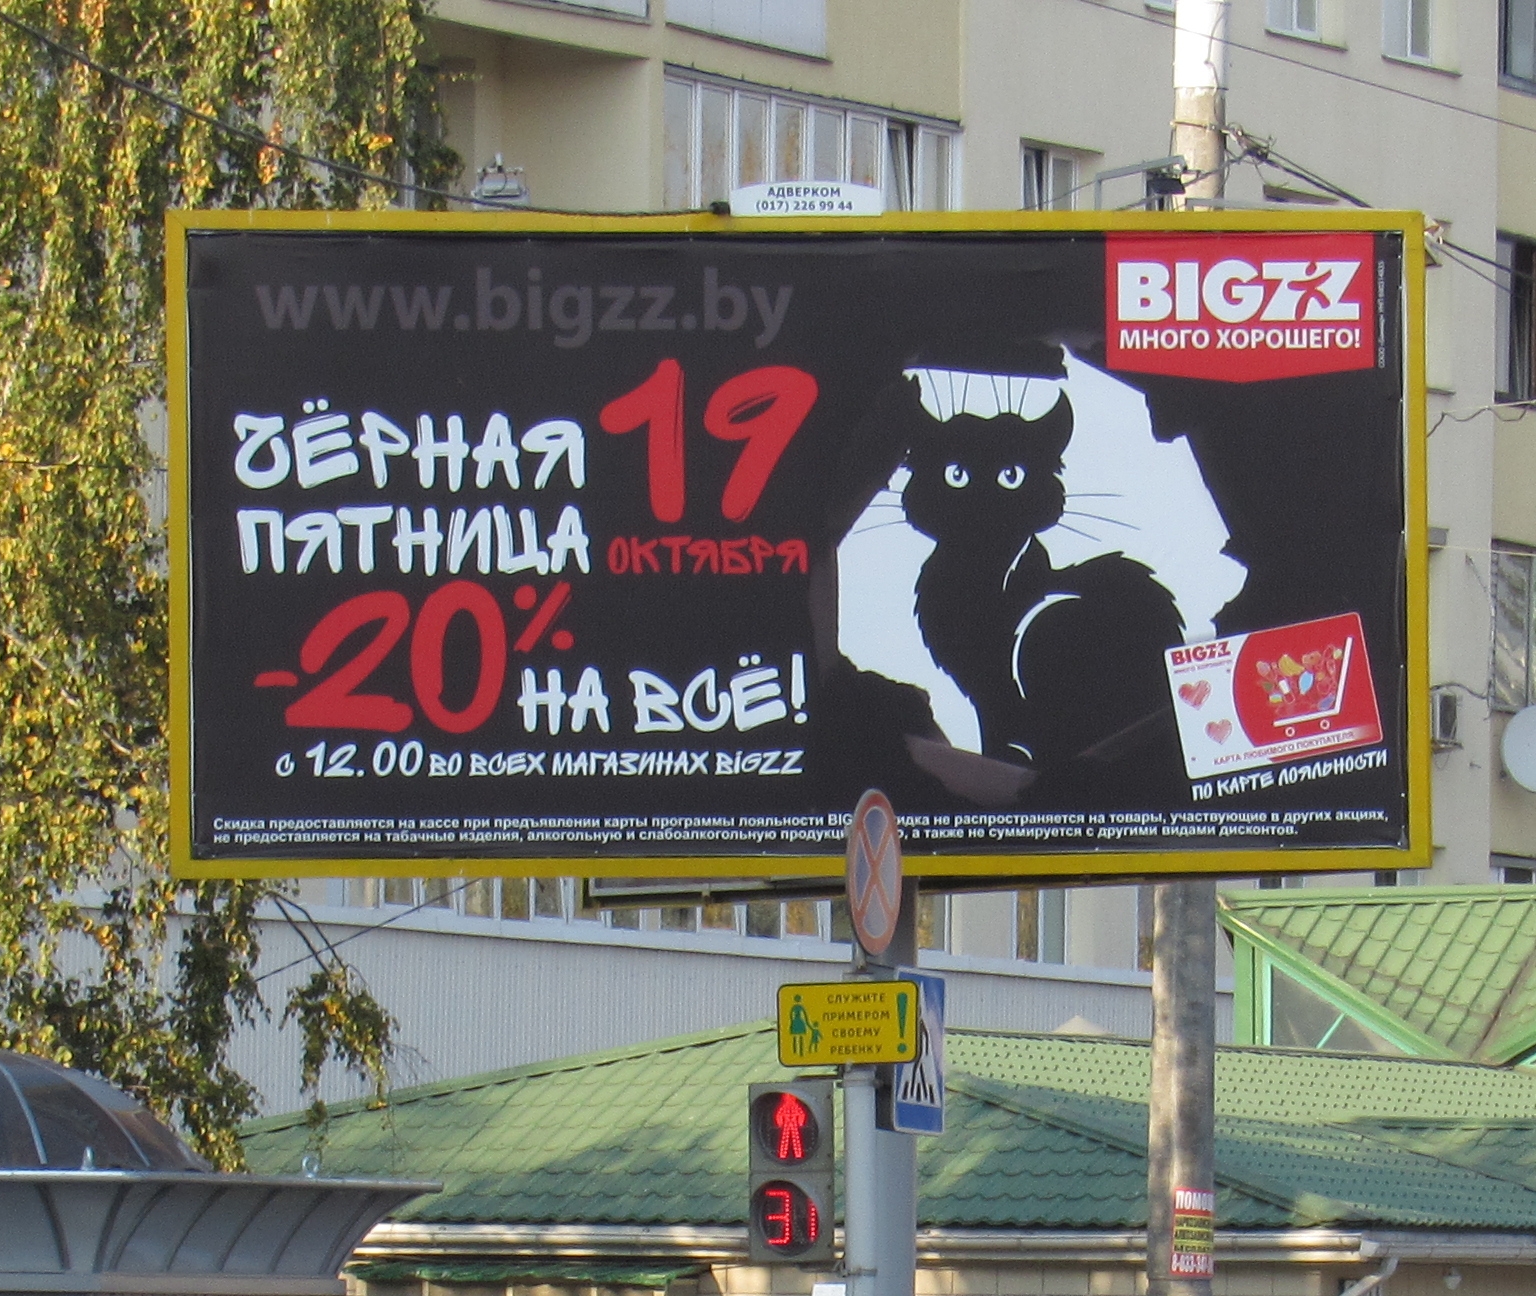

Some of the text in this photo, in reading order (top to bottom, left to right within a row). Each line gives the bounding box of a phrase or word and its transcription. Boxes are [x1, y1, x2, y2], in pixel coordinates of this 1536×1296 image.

[767, 187, 841, 199] АДВЕРКОМ
[755, 200, 853, 213] (017) 226 99 44
[256, 266, 793, 348] www.bigzz.by
[1119, 329, 1210, 350] МНОГО
[1216, 329, 1361, 350] ХОРОШЕГО!
[232, 398, 586, 491] ЧЁРНАЯ
[599, 358, 819, 522] 19
[236, 505, 590, 576] ПЯТНИЦА
[607, 536, 809, 575] ОКТЯБРЯ
[253, 579, 575, 734] -20%
[516, 653, 809, 735] НА ВСЁ!
[428, 753, 463, 777] ВО
[468, 751, 546, 777] ВСЕХ
[551, 750, 709, 776] МАГАЗИНАХ
[1213, 753, 1241, 766] КАРТА
[1191, 749, 1388, 801] ПО КАРТЕ ЛОЯЛЬНОСТИ
[214, 810, 1389, 831] Скидка предоставляется на кассе при предъявлении карты программы лояльности BIG идка не распространяется на товары, участвующие в других акциях,
[214, 832, 231, 843] не
[234, 832, 361, 845] предоставляется
[364, 832, 381, 842] на
[385, 830, 456, 843] табачные
[459, 830, 523, 843] изделия,
[527, 830, 623, 844] алкогольную
[626, 830, 636, 841] и
[639, 828, 777, 843] слабоалкогольную
[911, 828, 920, 839] а
[923, 828, 964, 839] также
[968, 827, 985, 838] не
[988, 827, 1083, 840] суммируется
[1085, 827, 1094, 837] с
[1097, 825, 1158, 840] другими
[1161, 825, 1215, 838] видами
[1218, 824, 1298, 837] дисконтов.
[827, 993, 886, 1004] СЛУЖИТЕ
[822, 1010, 890, 1022] ПРИМЕРОМ
[832, 1027, 881, 1039] СВОЕМУ
[830, 1044, 882, 1055] РЕБЕНКУ
